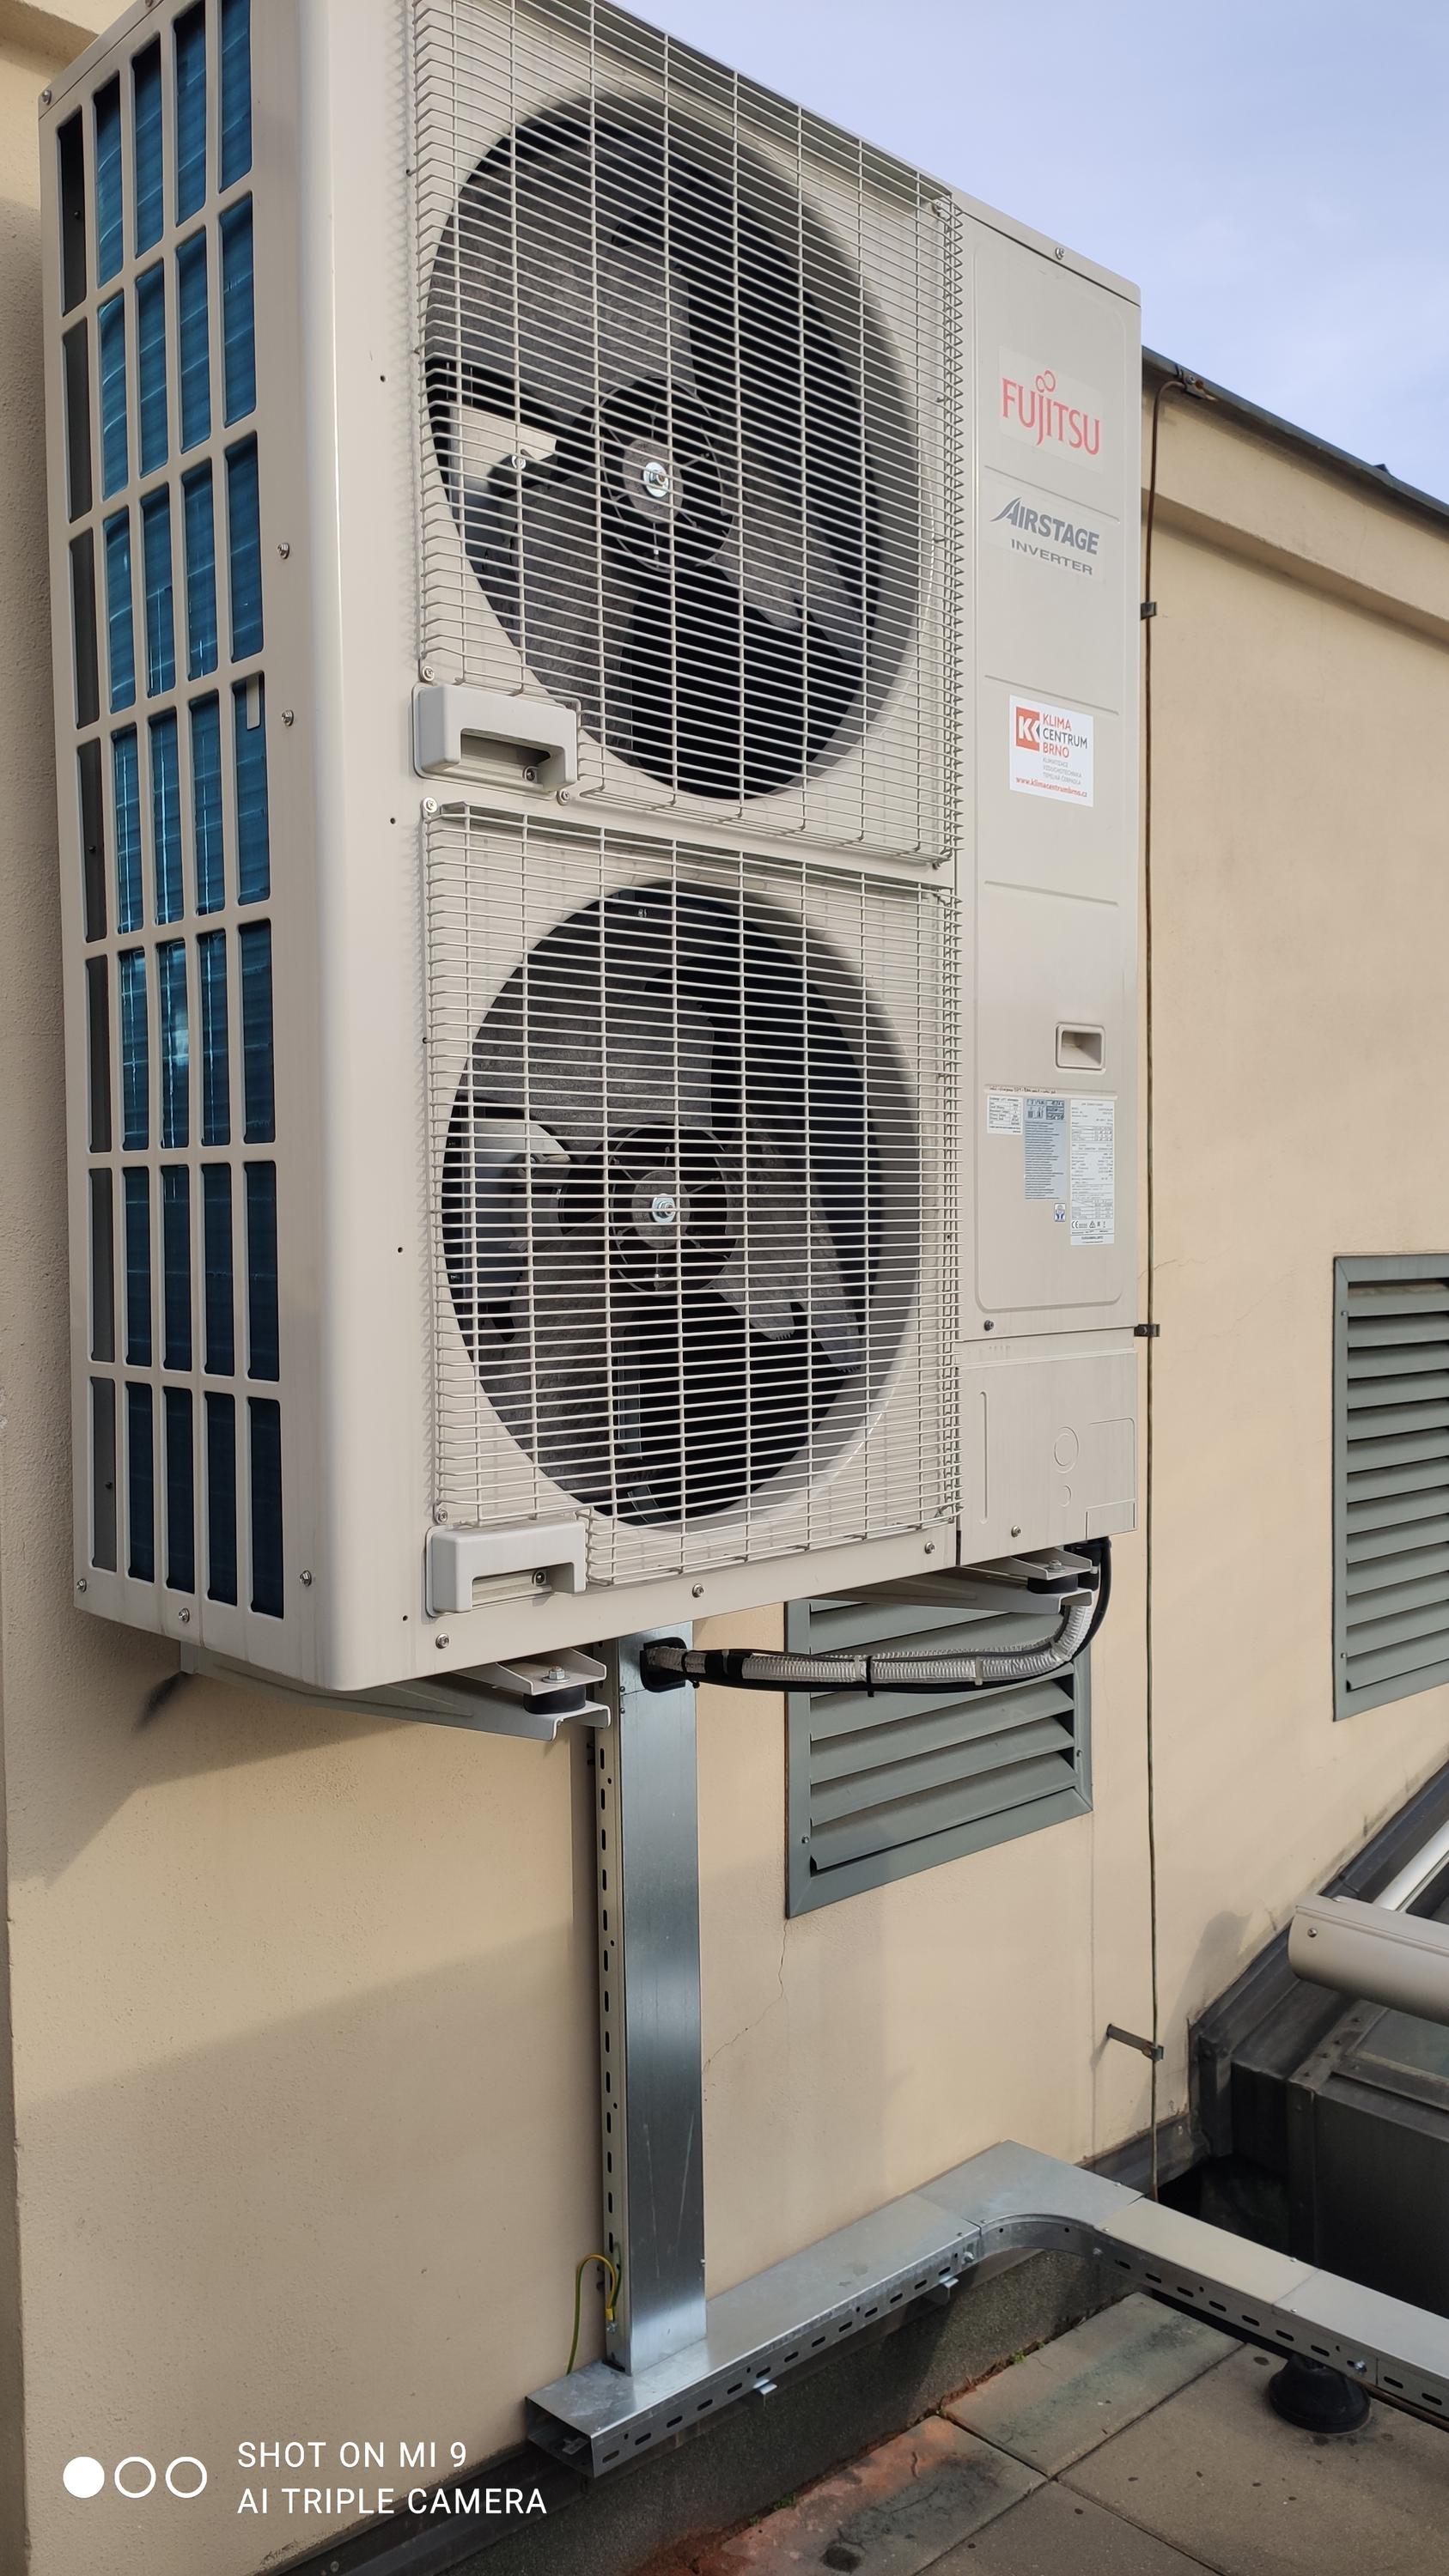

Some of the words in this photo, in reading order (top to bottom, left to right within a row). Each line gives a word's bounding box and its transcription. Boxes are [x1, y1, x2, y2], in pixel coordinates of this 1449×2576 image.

[1002, 374, 1100, 456] FUJITSU
[989, 496, 1100, 556] AIRSTAGE
[1011, 538, 1093, 575] INVERTER
[1043, 713, 1072, 732] KLIMA
[1043, 727, 1088, 750] CENTRUM
[1043, 742, 1070, 759] BRNO
